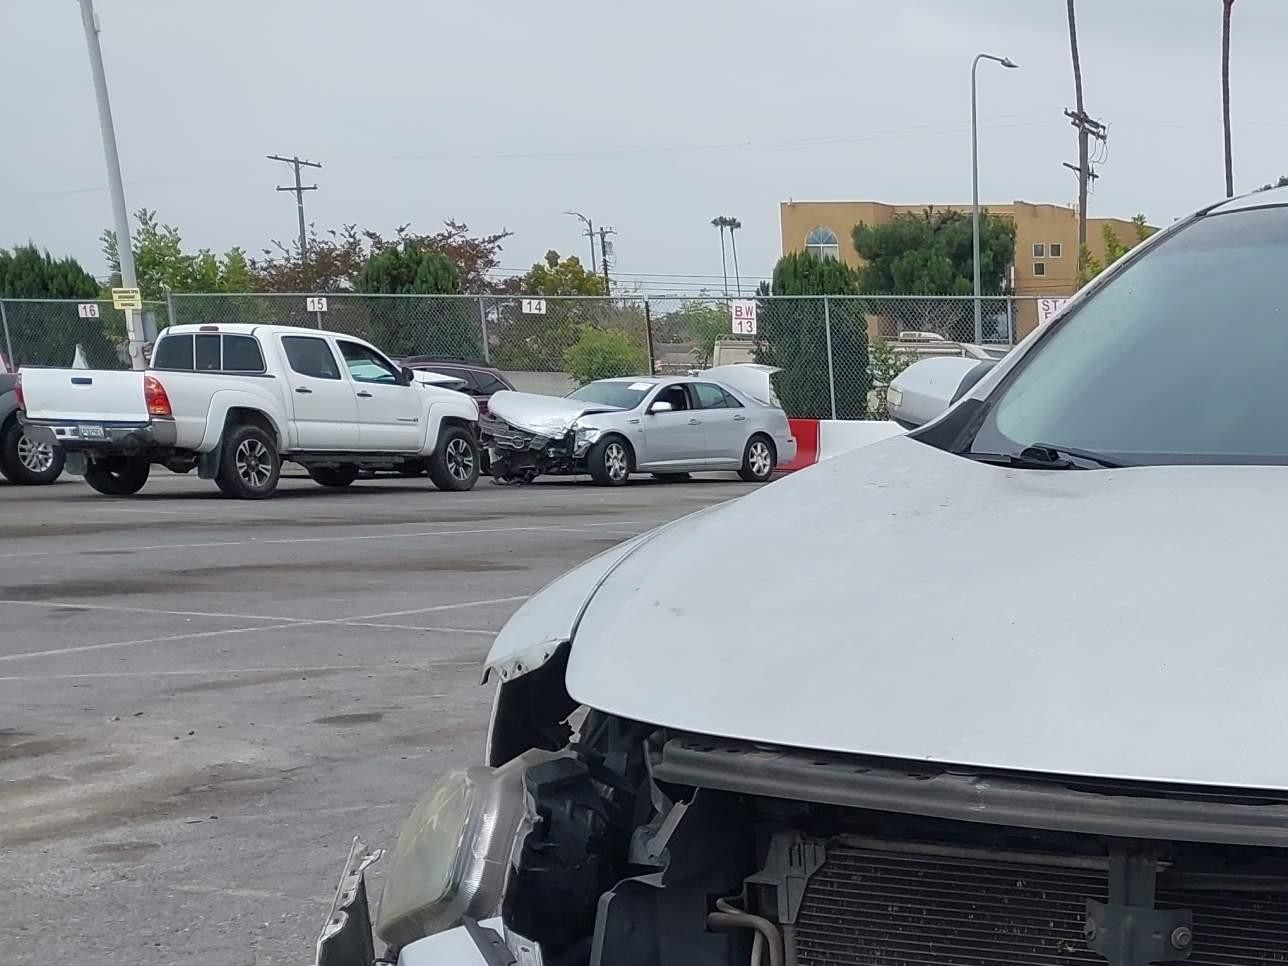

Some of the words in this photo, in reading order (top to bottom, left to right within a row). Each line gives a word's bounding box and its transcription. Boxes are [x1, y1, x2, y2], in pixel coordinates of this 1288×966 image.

[310, 298, 324, 310] 15
[527, 300, 542, 312] 14
[83, 305, 96, 317] 16
[737, 320, 754, 333] 13
